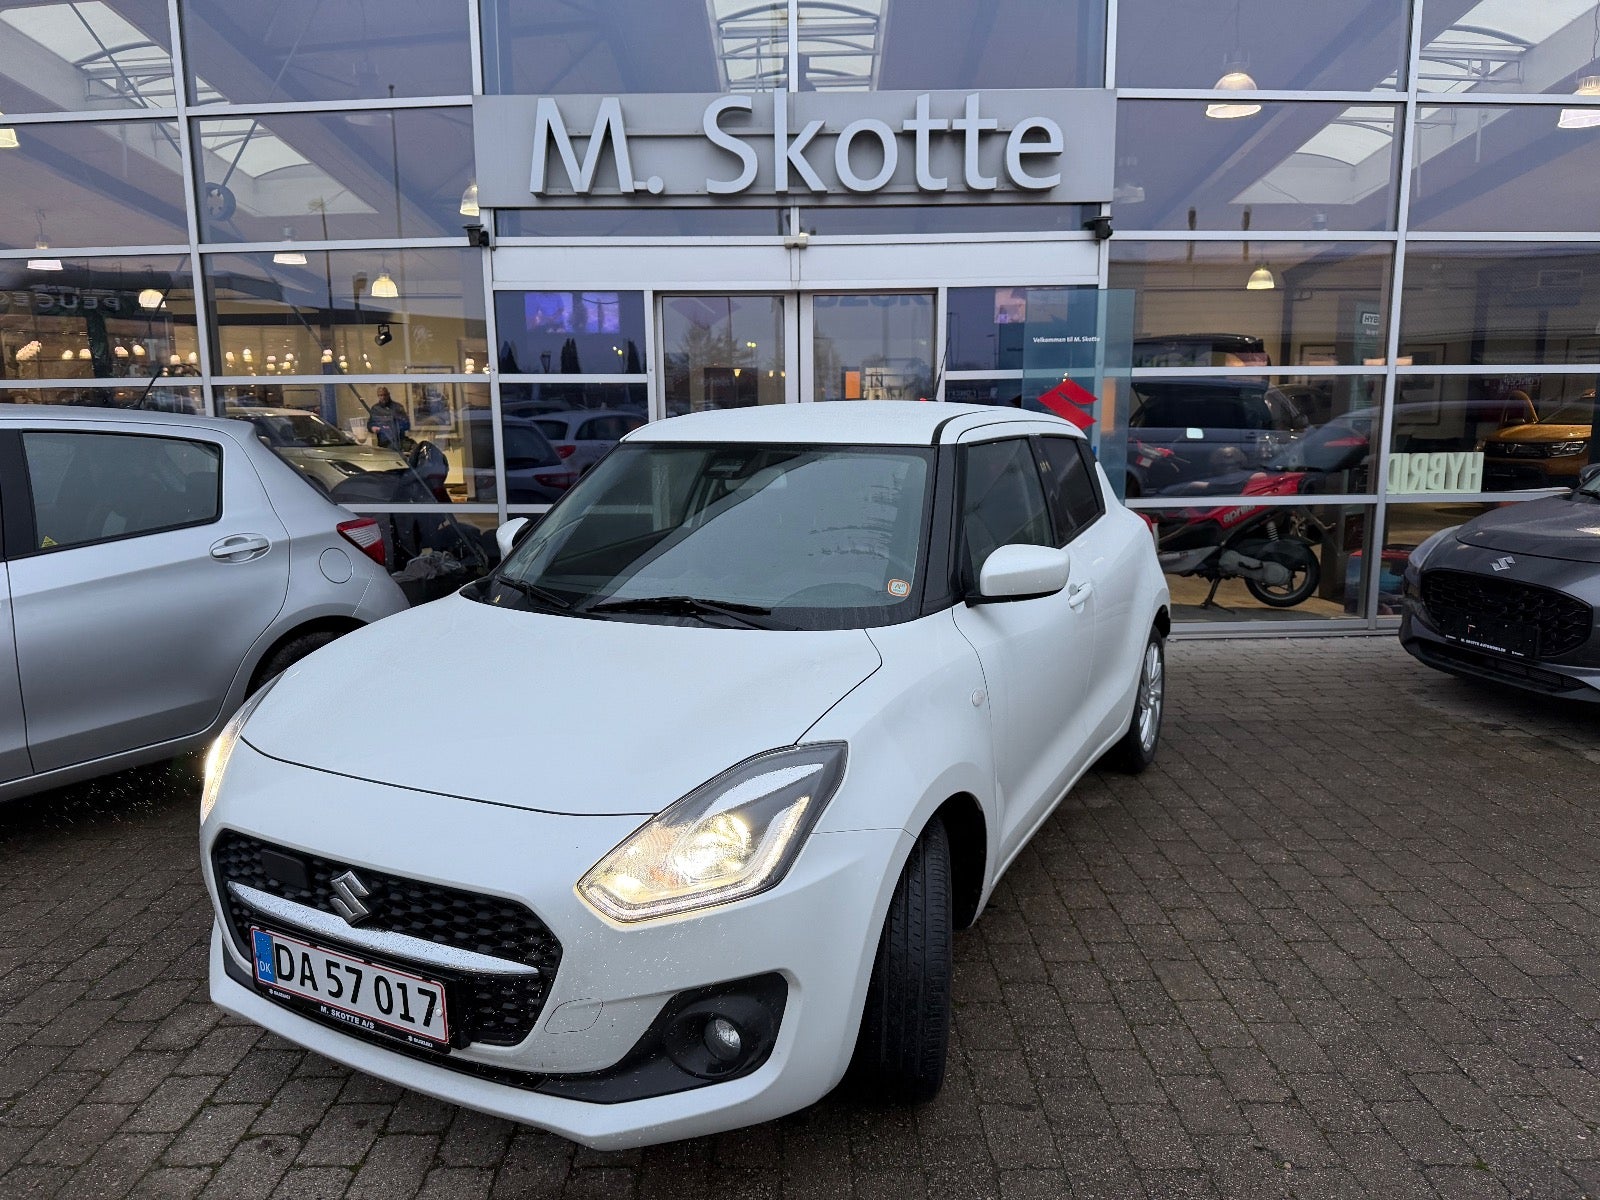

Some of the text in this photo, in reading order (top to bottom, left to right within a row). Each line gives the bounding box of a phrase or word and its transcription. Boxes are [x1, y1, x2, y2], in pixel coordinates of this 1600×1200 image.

[529, 87, 1065, 196] M. Skotte
[259, 960, 272, 975] DK
[274, 942, 437, 1028] DA 57 017
[320, 1005, 375, 1030] M. SKOTTE A/S
